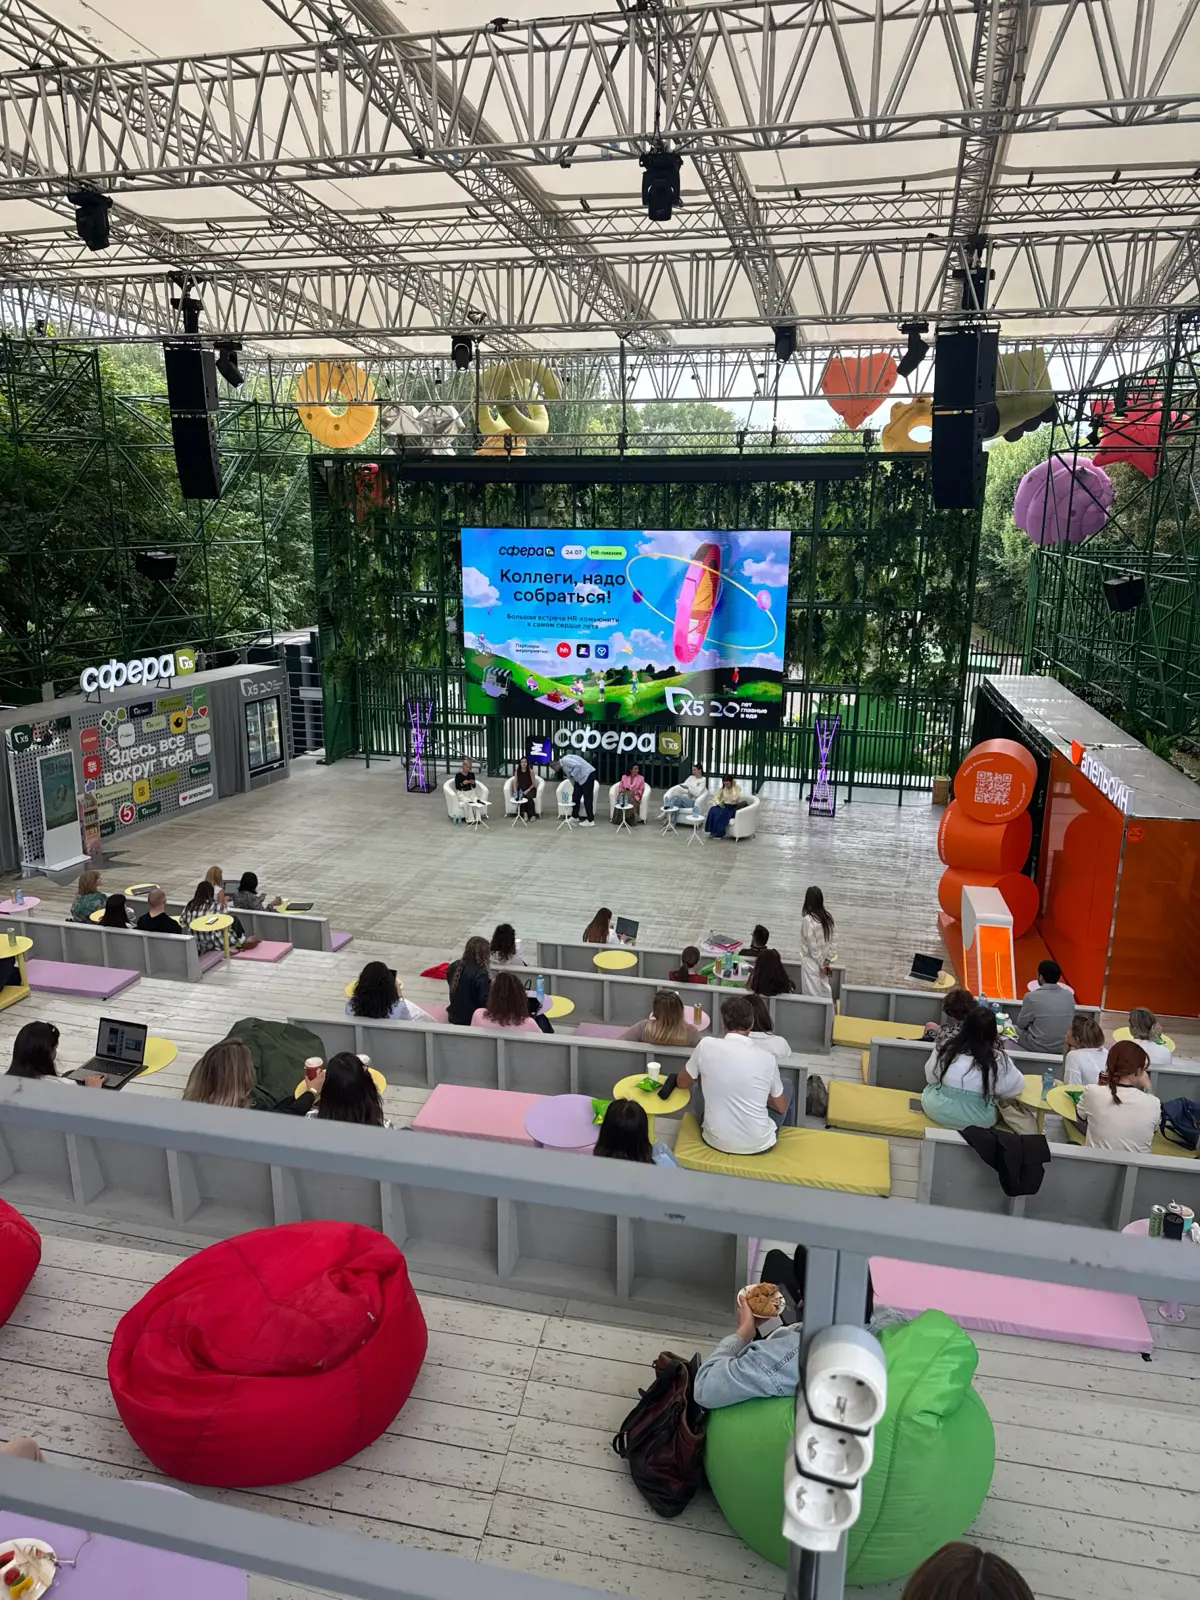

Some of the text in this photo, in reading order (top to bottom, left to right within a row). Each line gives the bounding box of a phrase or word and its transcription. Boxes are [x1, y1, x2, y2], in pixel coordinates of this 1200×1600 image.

[499, 545, 544, 557] сфера
[500, 569, 626, 587] Коллеги, надо
[513, 588, 611, 605] собраться!
[80, 654, 175, 692] сфера
[680, 699, 705, 716] X5
[109, 735, 186, 766] Здесь все
[554, 725, 656, 754] сфера
[103, 759, 157, 786] вокруг
[160, 747, 193, 768] тебя
[1080, 752, 1131, 815] апельсин
